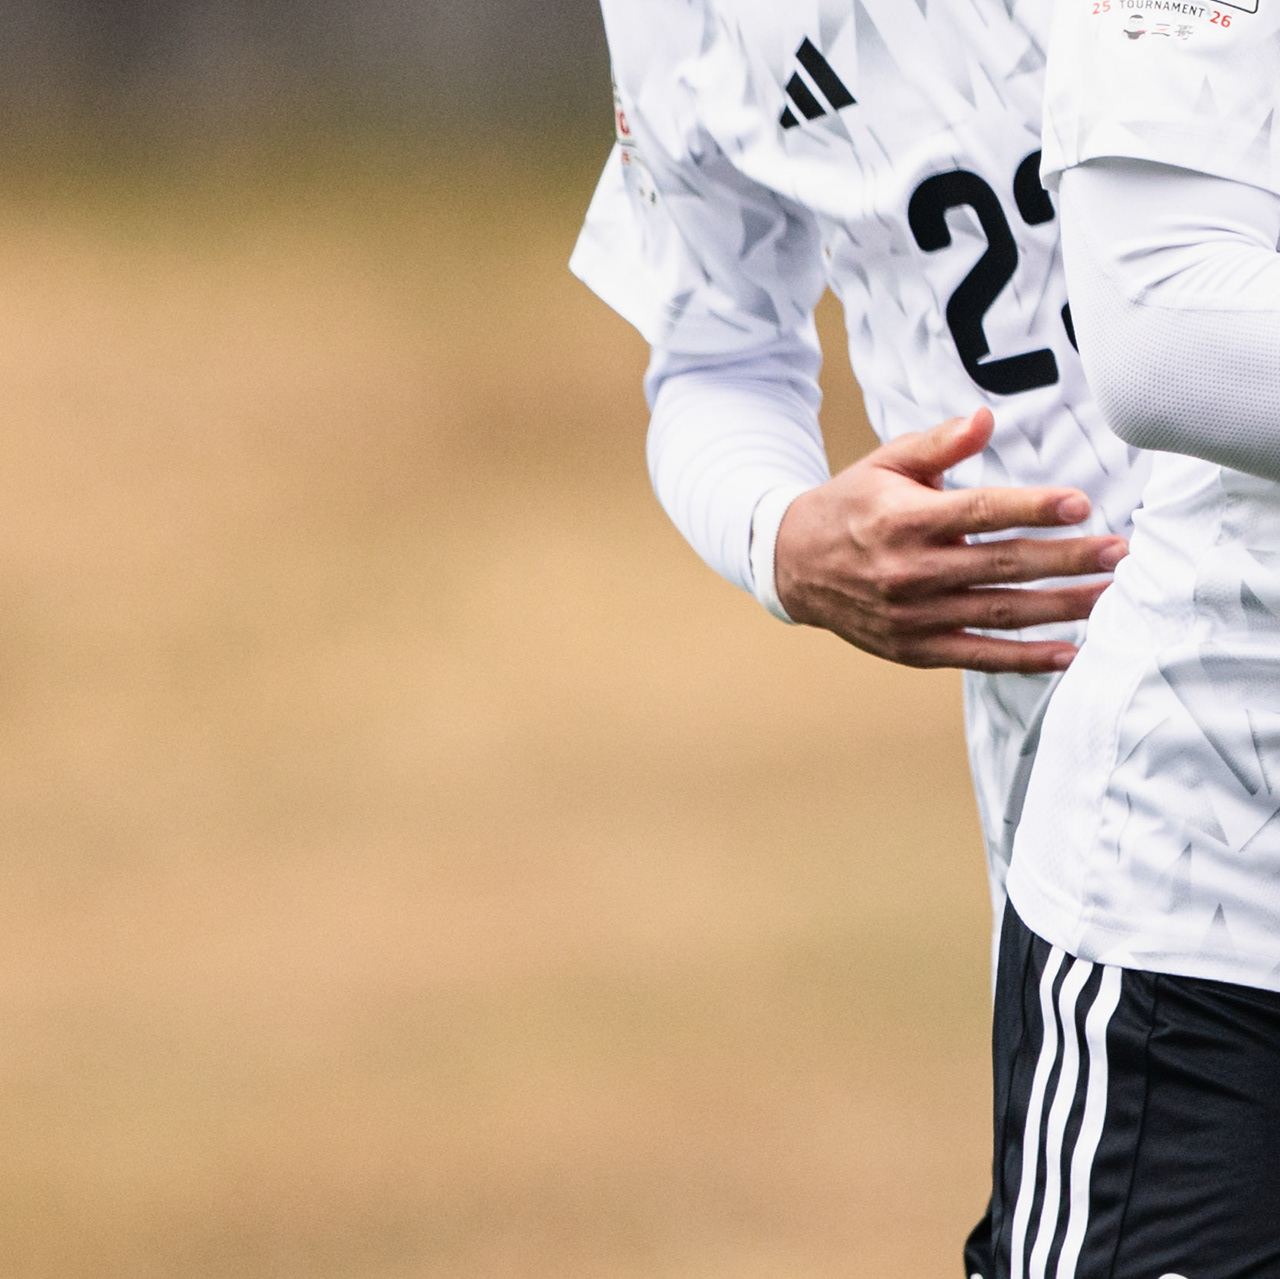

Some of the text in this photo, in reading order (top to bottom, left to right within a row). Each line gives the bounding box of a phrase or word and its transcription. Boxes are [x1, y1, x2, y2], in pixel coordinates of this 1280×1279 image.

[1092, 0, 1232, 28] 25 TOURNAMENT 26
